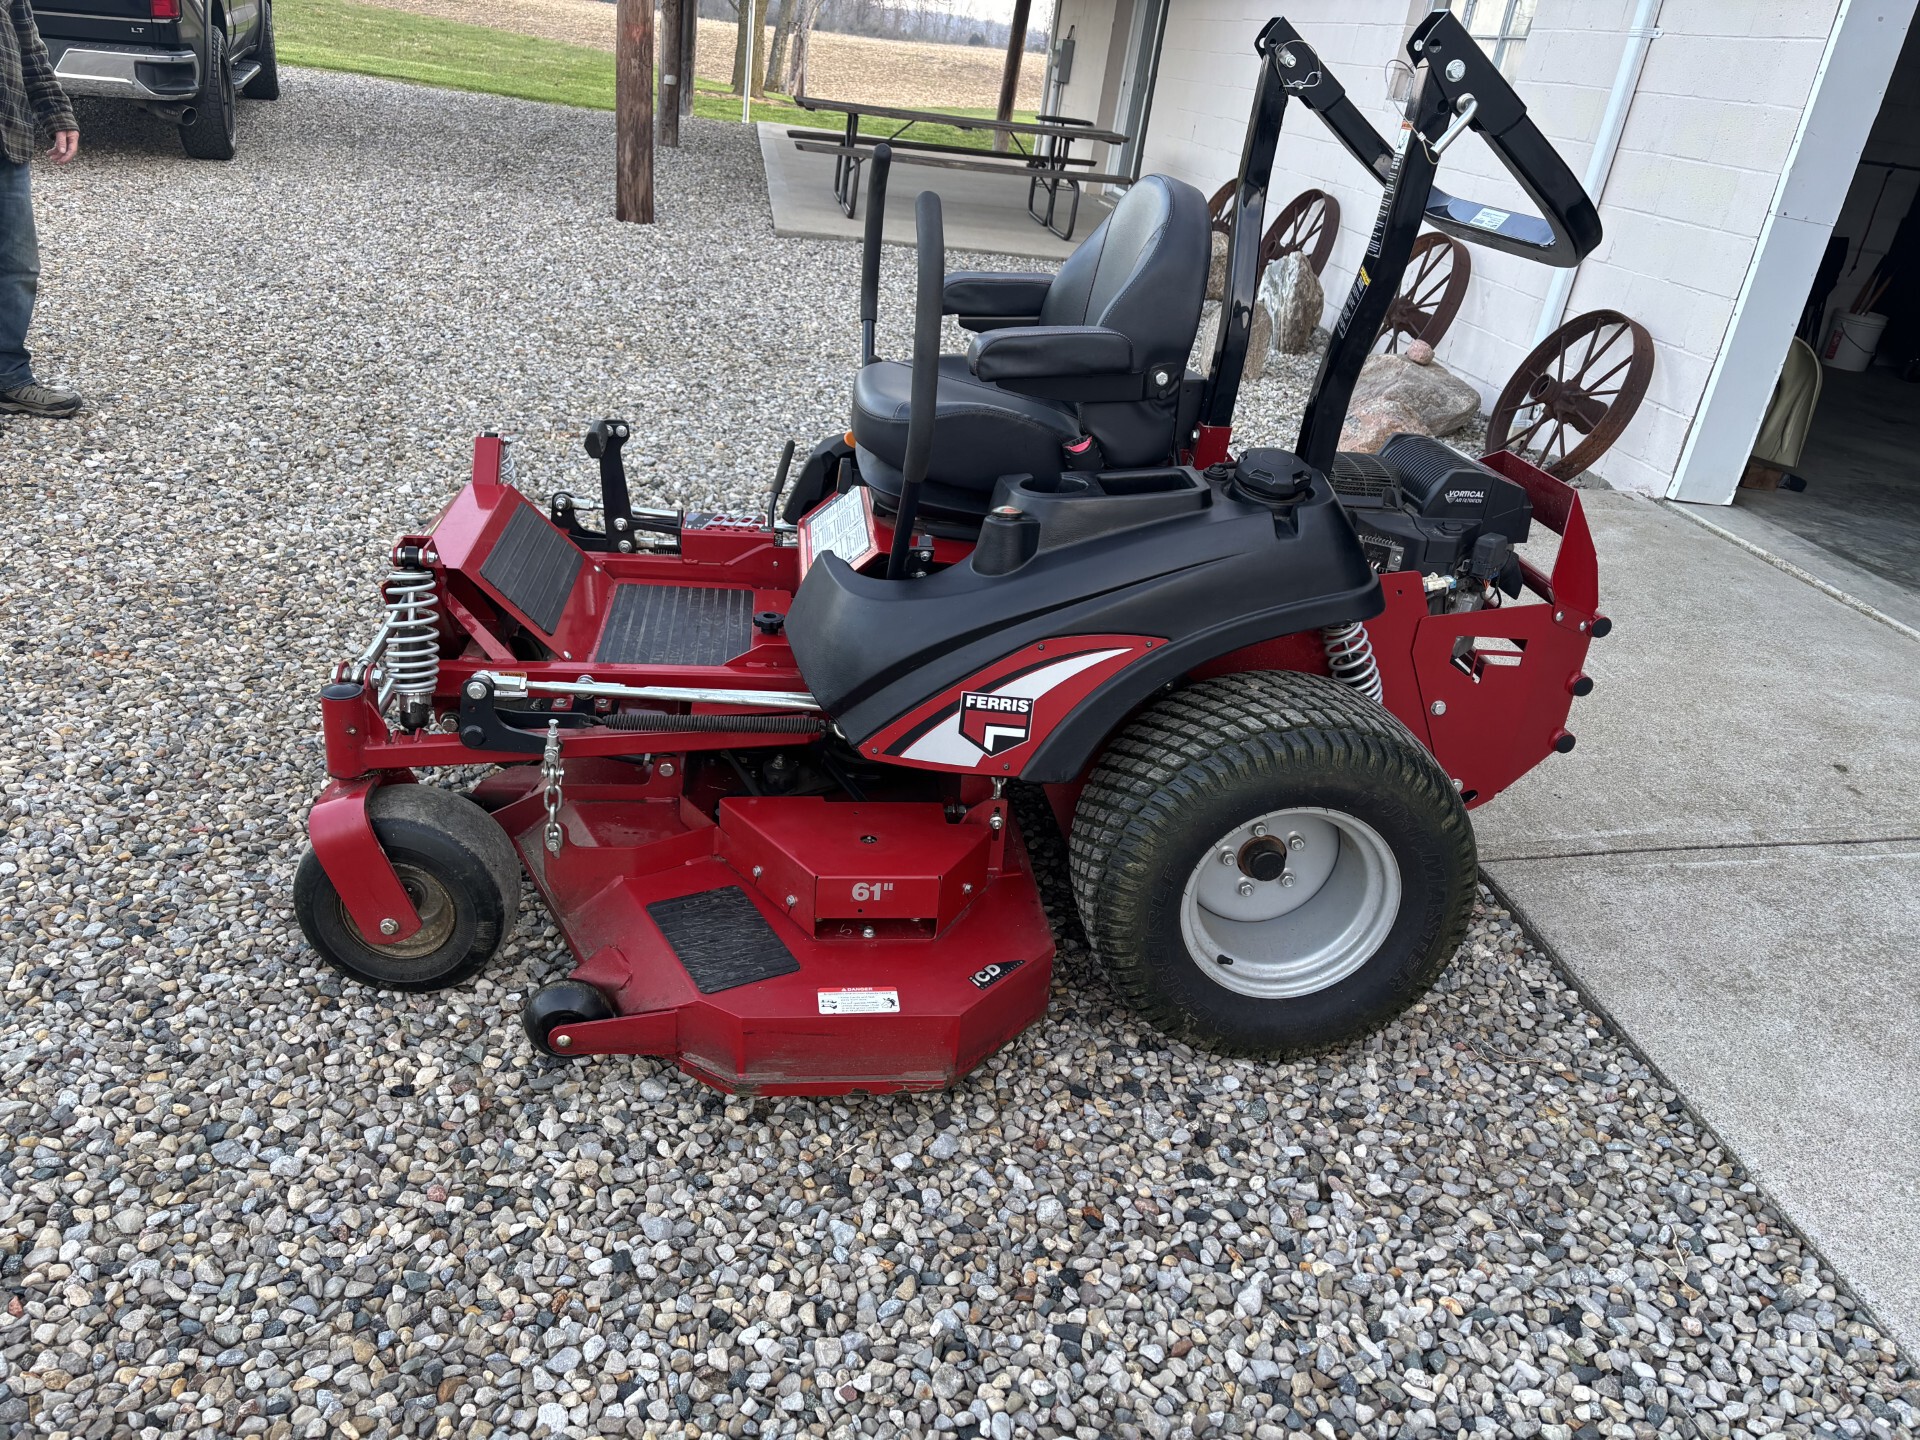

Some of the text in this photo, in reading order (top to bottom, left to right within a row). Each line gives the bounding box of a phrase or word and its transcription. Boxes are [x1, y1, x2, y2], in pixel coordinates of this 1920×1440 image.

[1449, 490, 1484, 498] VORTICAL
[965, 695, 1029, 713] FERRIS
[852, 882, 893, 901] 61"
[969, 964, 1001, 987] iCD
